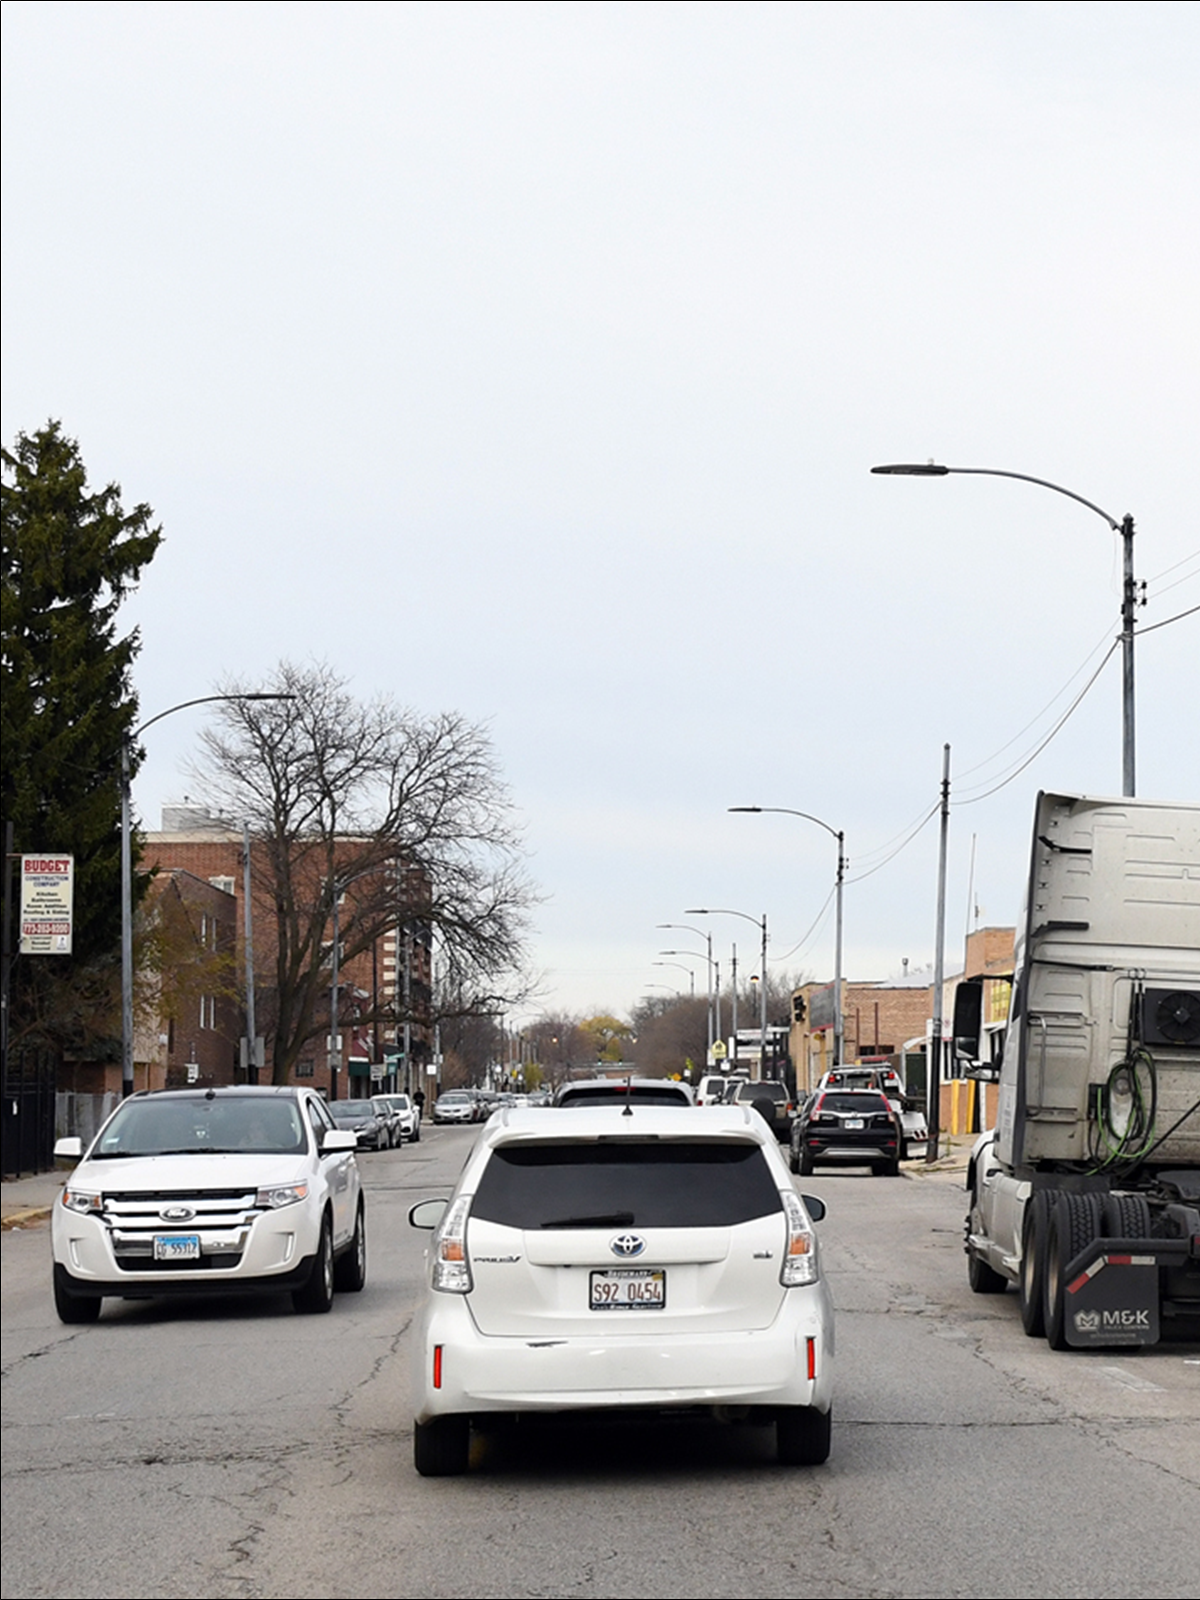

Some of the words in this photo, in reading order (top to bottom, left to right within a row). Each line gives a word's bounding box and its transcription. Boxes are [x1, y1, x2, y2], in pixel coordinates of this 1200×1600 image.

[24, 859, 70, 872] BUDGET
[594, 1282, 619, 1302] S92
[628, 1282, 661, 1302] 0454
[1103, 1310, 1149, 1324] M&K
